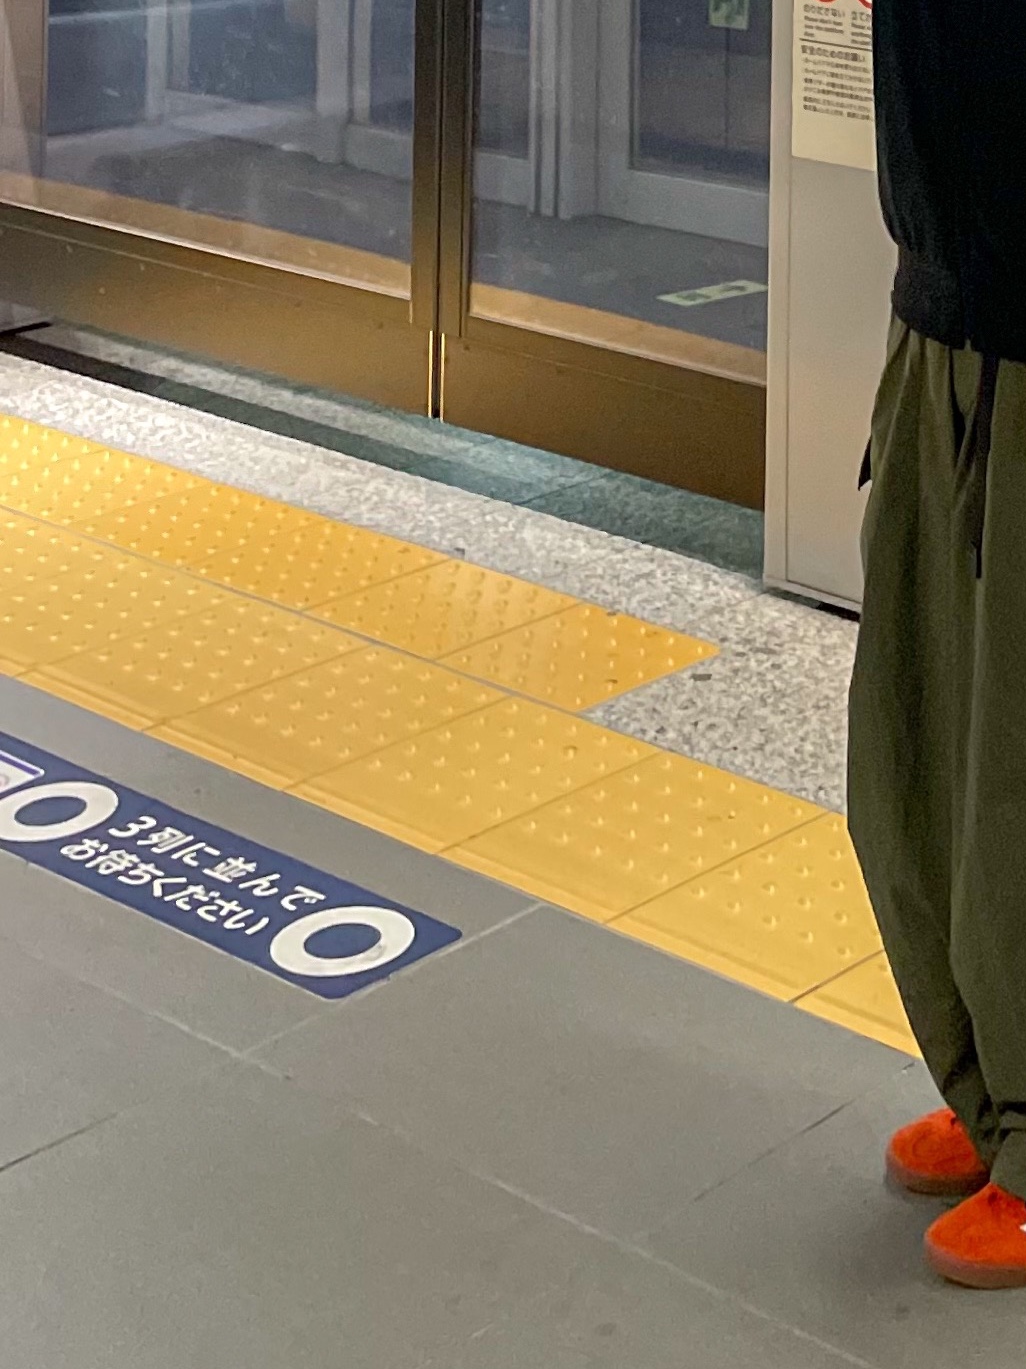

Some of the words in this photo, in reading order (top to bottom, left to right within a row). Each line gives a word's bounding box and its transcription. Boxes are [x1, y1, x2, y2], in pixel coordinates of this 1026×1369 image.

[60, 837, 271, 936] お待ちください
[107, 815, 326, 912] 3列に並んで
